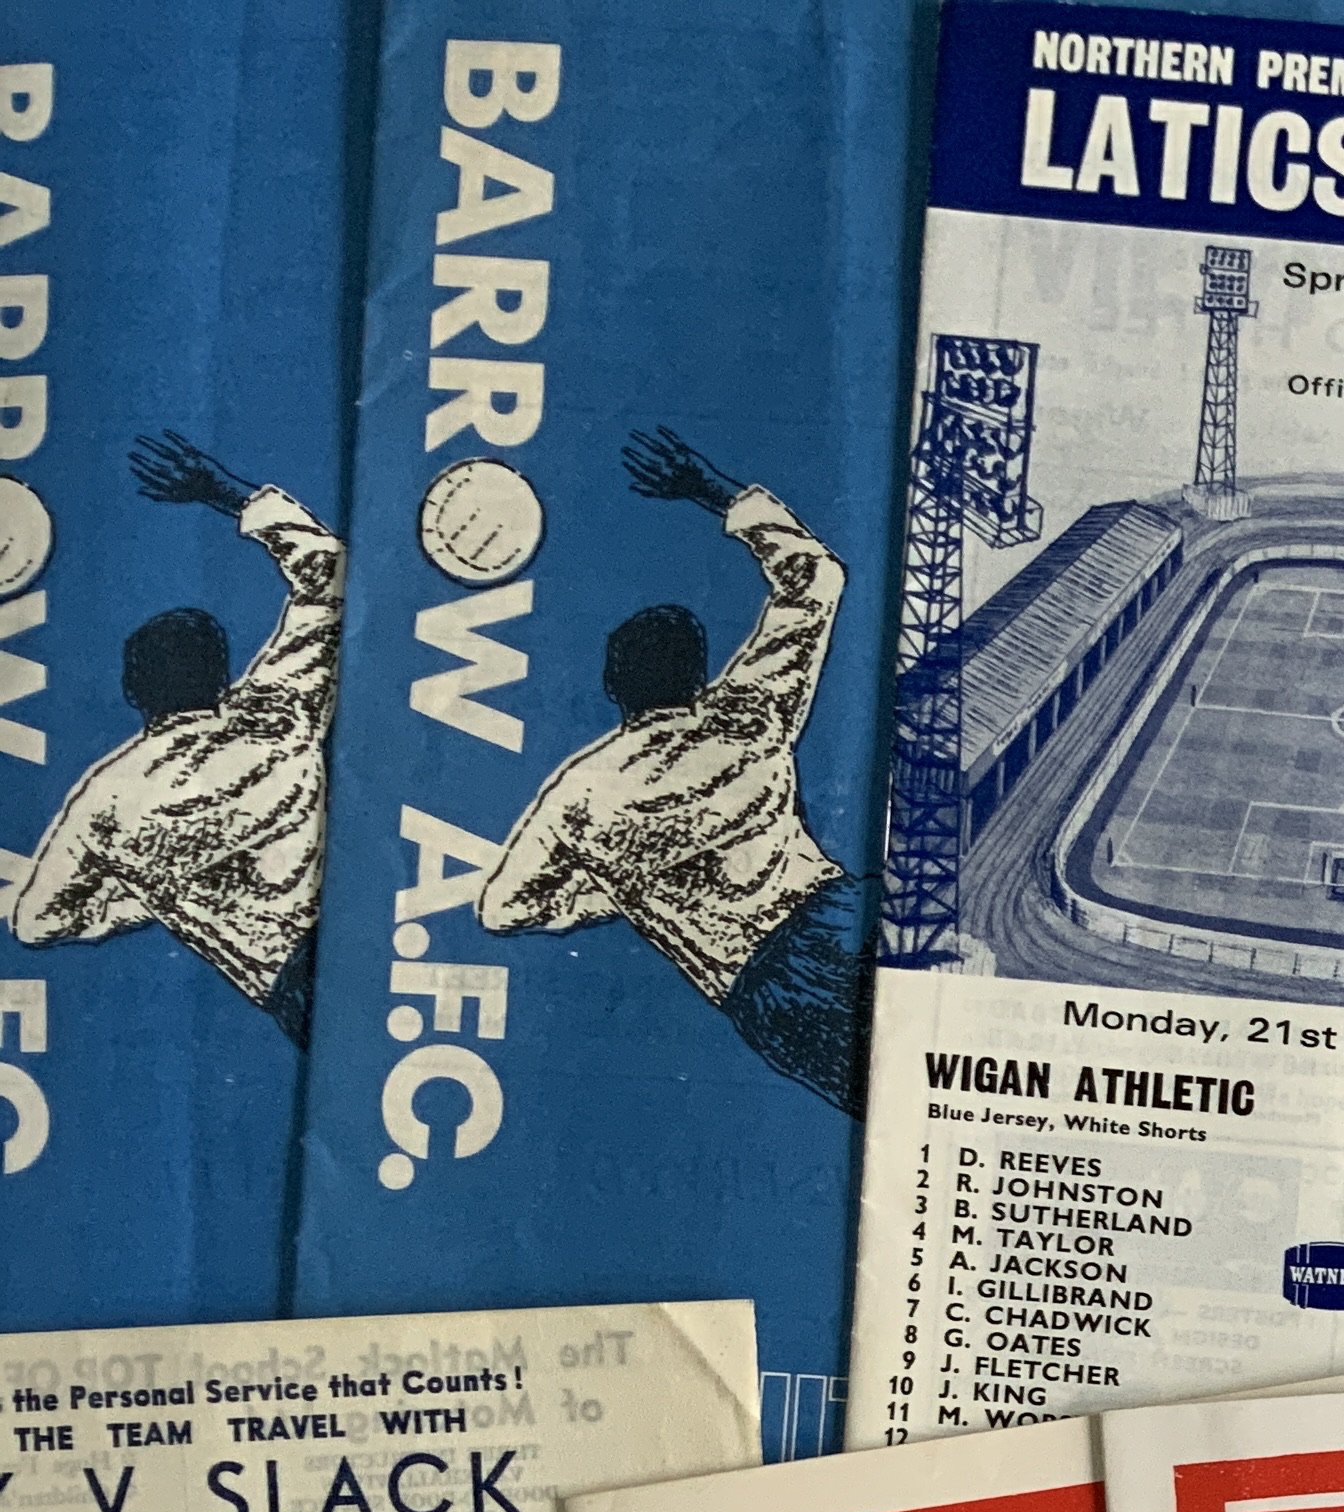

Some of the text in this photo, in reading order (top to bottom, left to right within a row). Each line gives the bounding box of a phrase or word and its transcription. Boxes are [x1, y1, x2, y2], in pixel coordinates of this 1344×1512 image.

[1033, 30, 1234, 85] NORTHERN
[926, 1053, 1254, 1116] WIGAN ATHLETIC
[13, 1388, 58, 1412] the
[71, 1381, 194, 1409] Personal
[205, 1376, 317, 1403] Service
[328, 1373, 391, 1397] that
[14, 1408, 466, 1451] THE TEAM TRAVEL WITH
